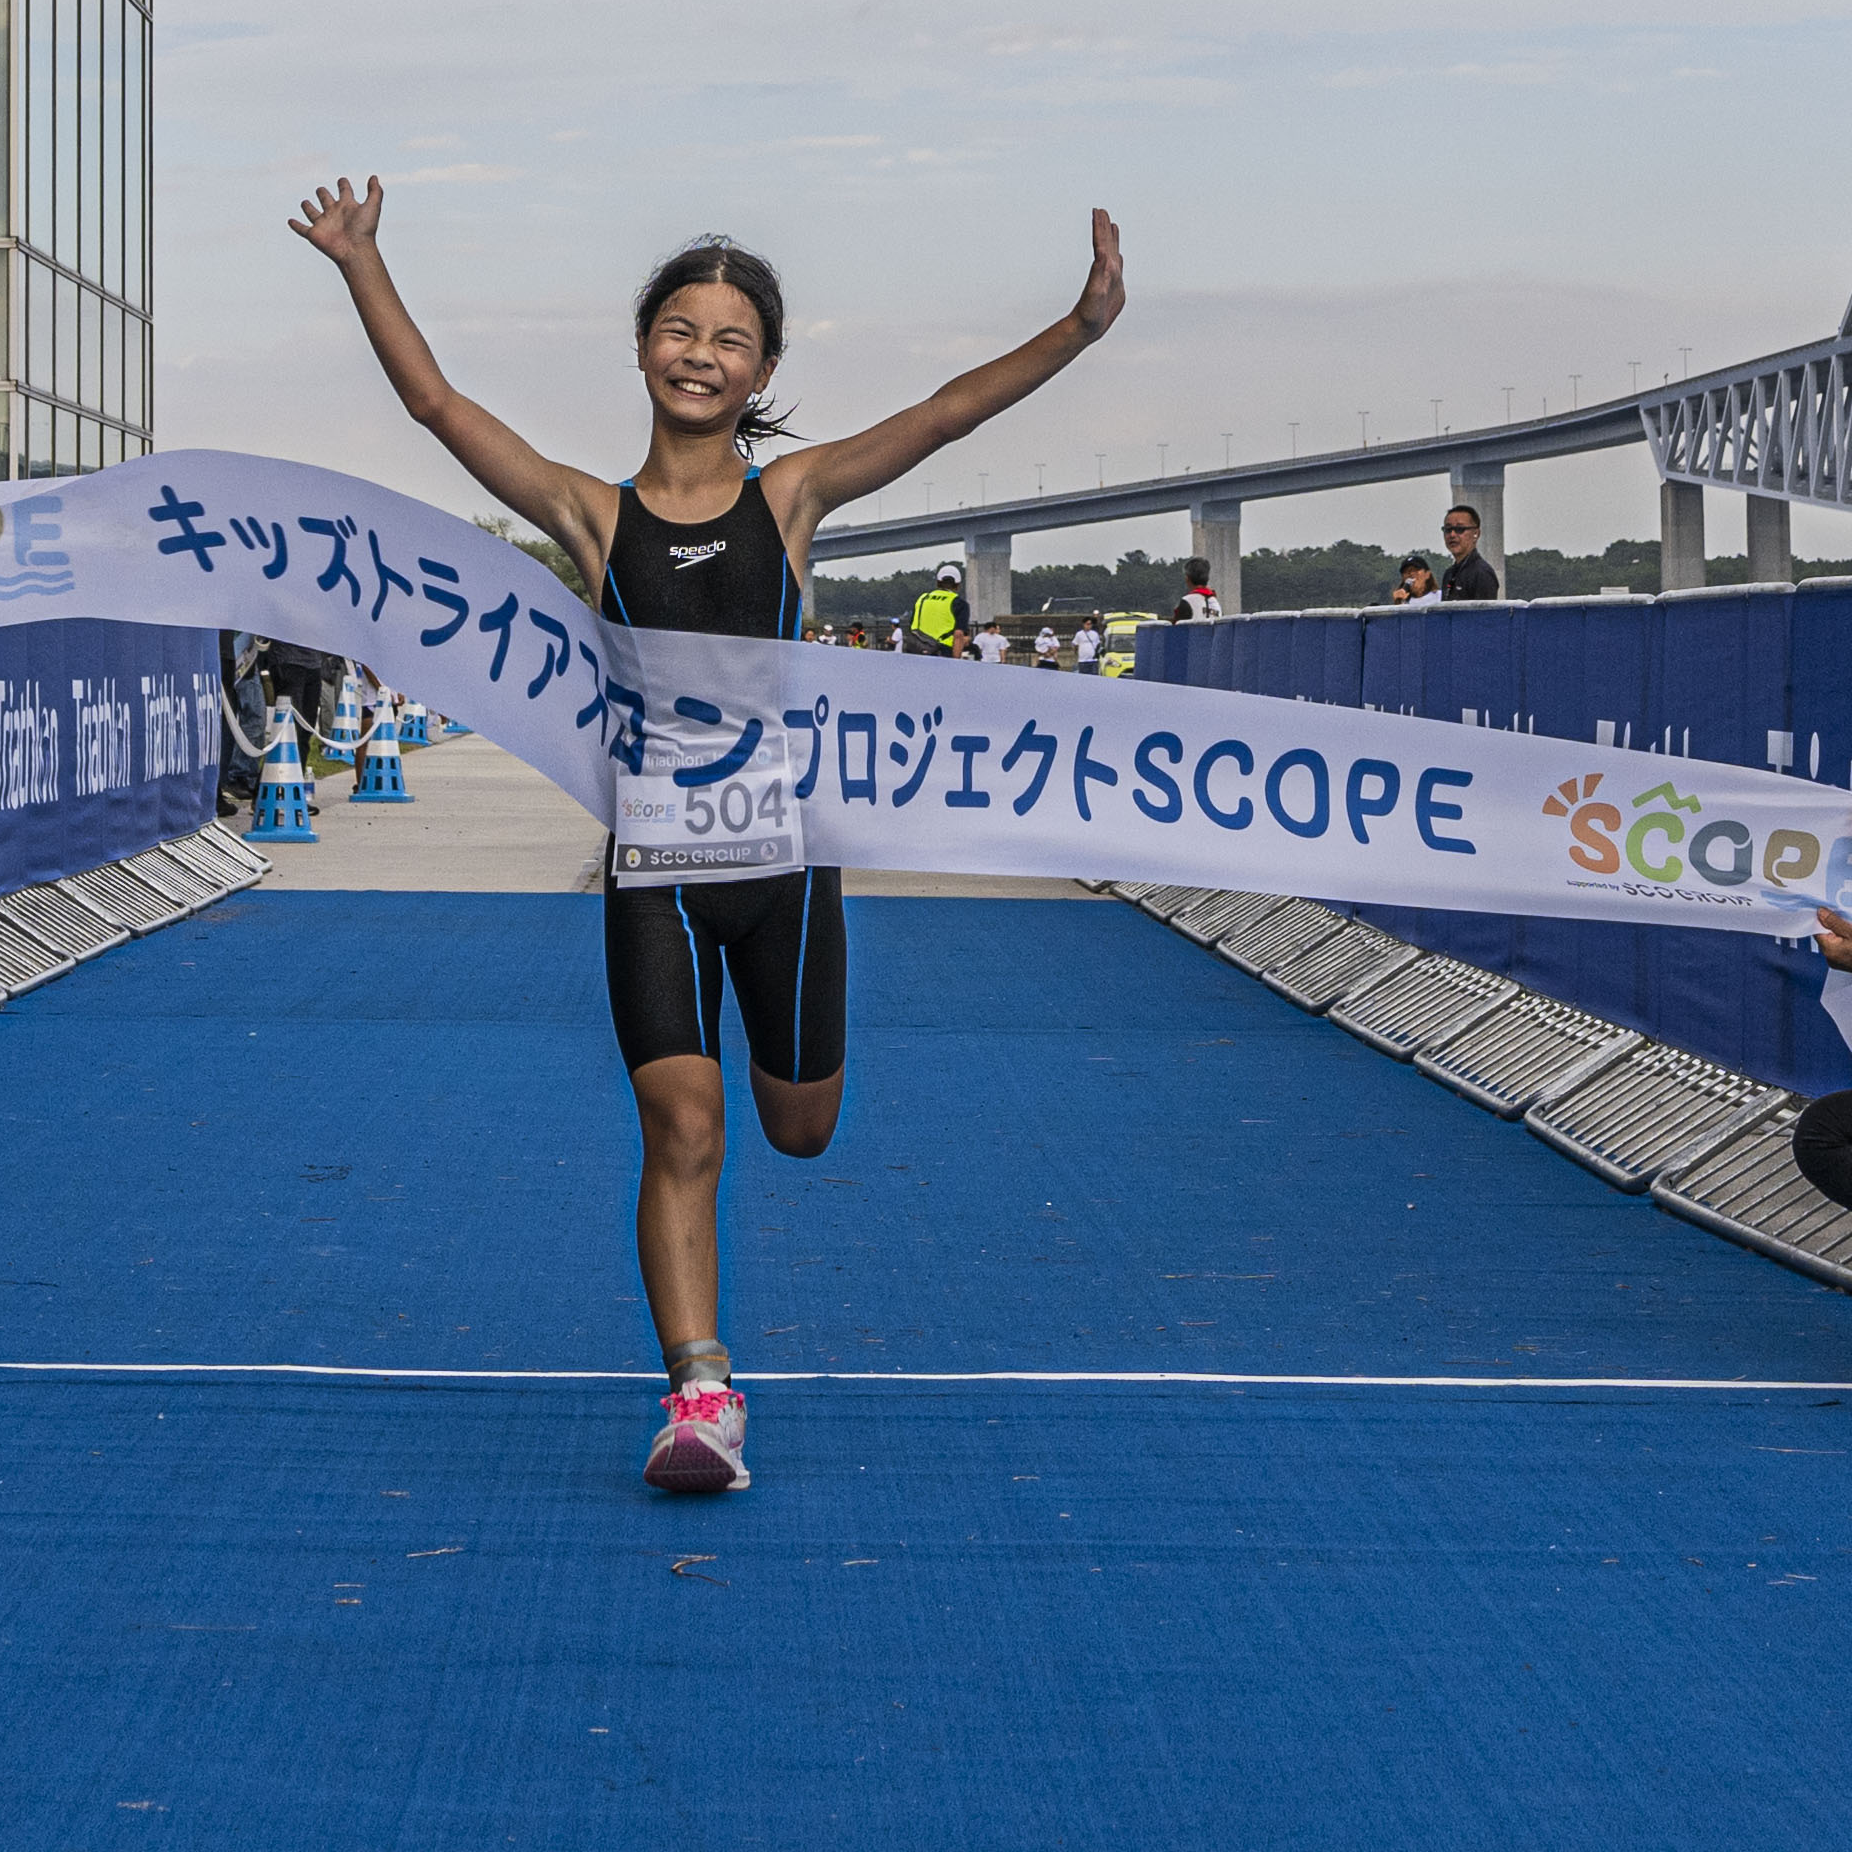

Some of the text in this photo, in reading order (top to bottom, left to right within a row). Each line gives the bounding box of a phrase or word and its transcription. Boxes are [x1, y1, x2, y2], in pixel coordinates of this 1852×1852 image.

[669, 539, 727, 559] speedo
[71, 676, 131, 797] Triathlon
[141, 673, 189, 783] Triathlon
[623, 802, 677, 819] SCOPE
[684, 777, 787, 836] 504
[650, 847, 752, 866] SCO GROUP
